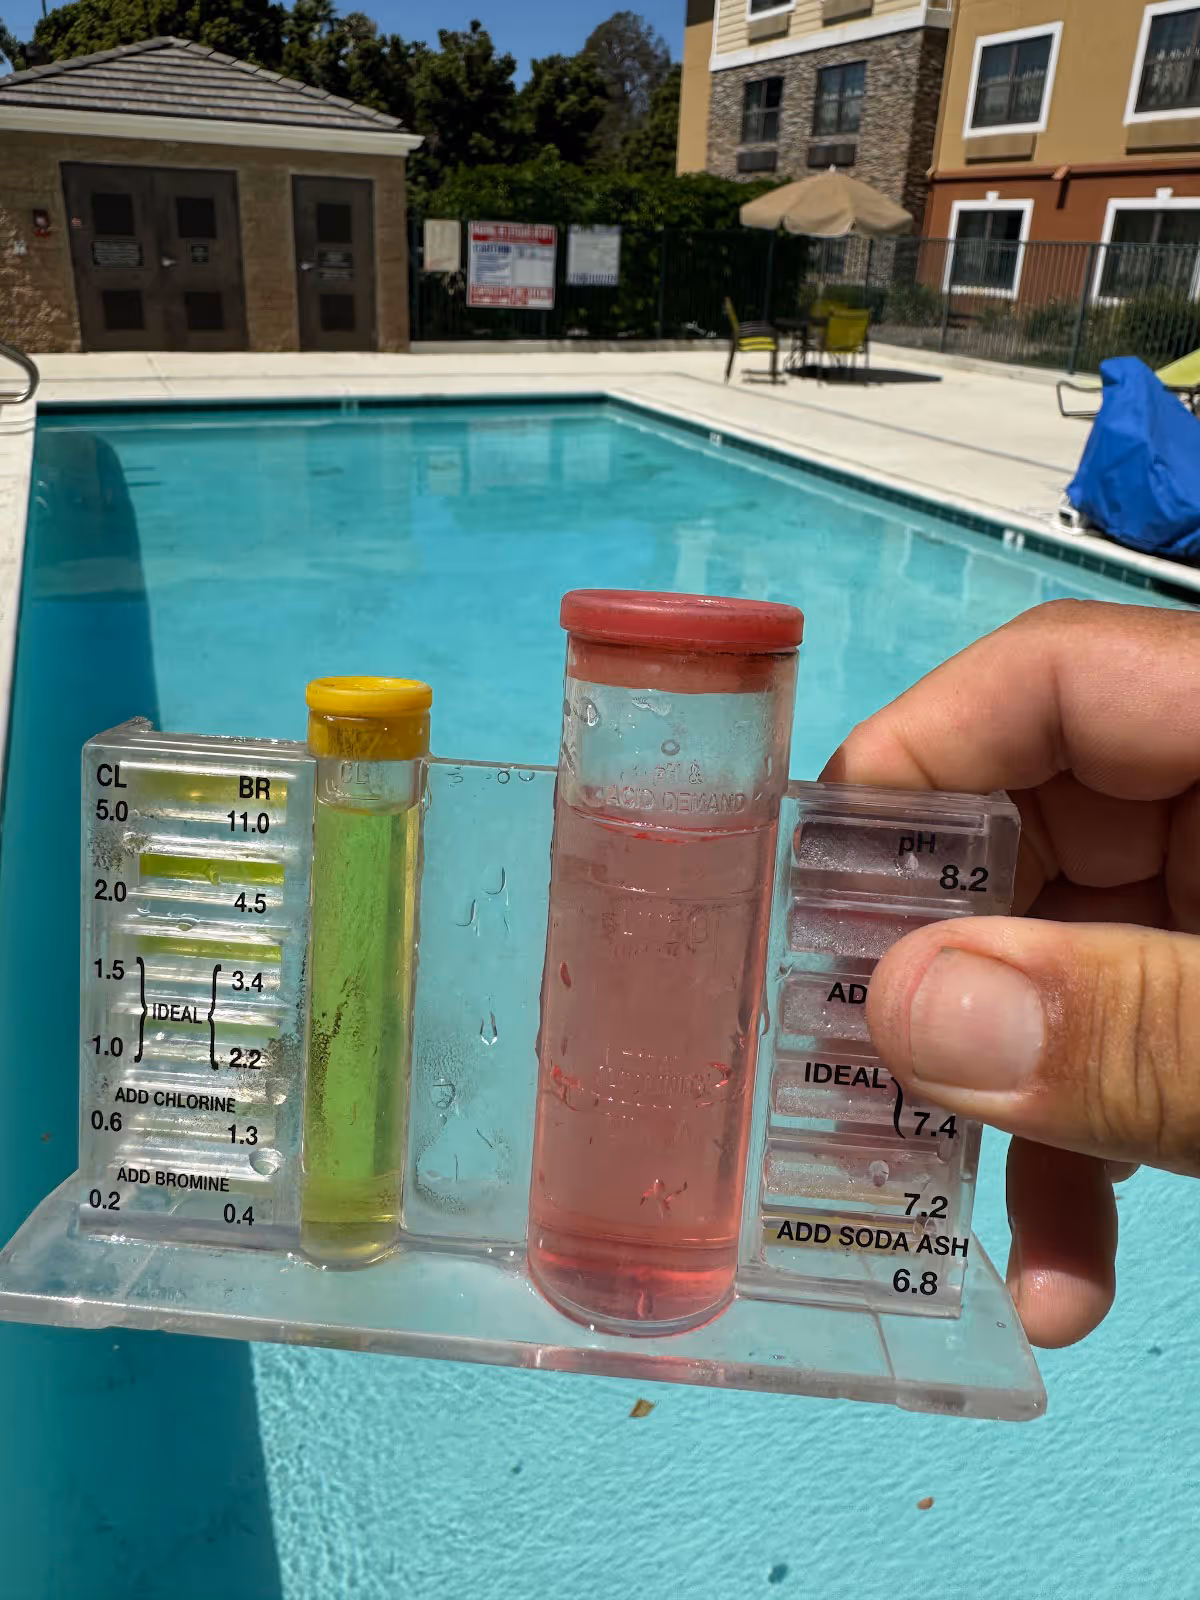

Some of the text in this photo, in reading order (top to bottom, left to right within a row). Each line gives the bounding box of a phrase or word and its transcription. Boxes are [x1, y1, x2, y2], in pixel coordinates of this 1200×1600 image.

[97, 763, 128, 788] CL
[239, 776, 271, 800] BR
[96, 799, 129, 822] 5.0
[227, 810, 270, 833] 11.0
[898, 831, 936, 856] pH
[939, 864, 989, 892] 8.2
[94, 879, 127, 902] 2.0
[234, 893, 267, 914] 4.5
[94, 958, 125, 980] 1.5
[231, 970, 264, 992] 3.4
[826, 982, 868, 1004] AD
[152, 1002, 202, 1024] IDEAL
[92, 1035, 124, 1057] 1.0
[229, 1048, 261, 1070] 2.2
[804, 1062, 887, 1089] IDEAL
[115, 1086, 236, 1113] ADD CHLORINE
[91, 1110, 122, 1132] 0.6
[913, 1111, 957, 1139] 7.4
[227, 1124, 258, 1145] 1.3
[117, 1167, 230, 1192] ADD BROMINE
[89, 1189, 121, 1211] 0.2
[904, 1193, 948, 1219] 7.2
[223, 1203, 255, 1226] 0.4
[777, 1220, 969, 1258] ADD SODA ASH
[893, 1268, 938, 1296] 6.8
